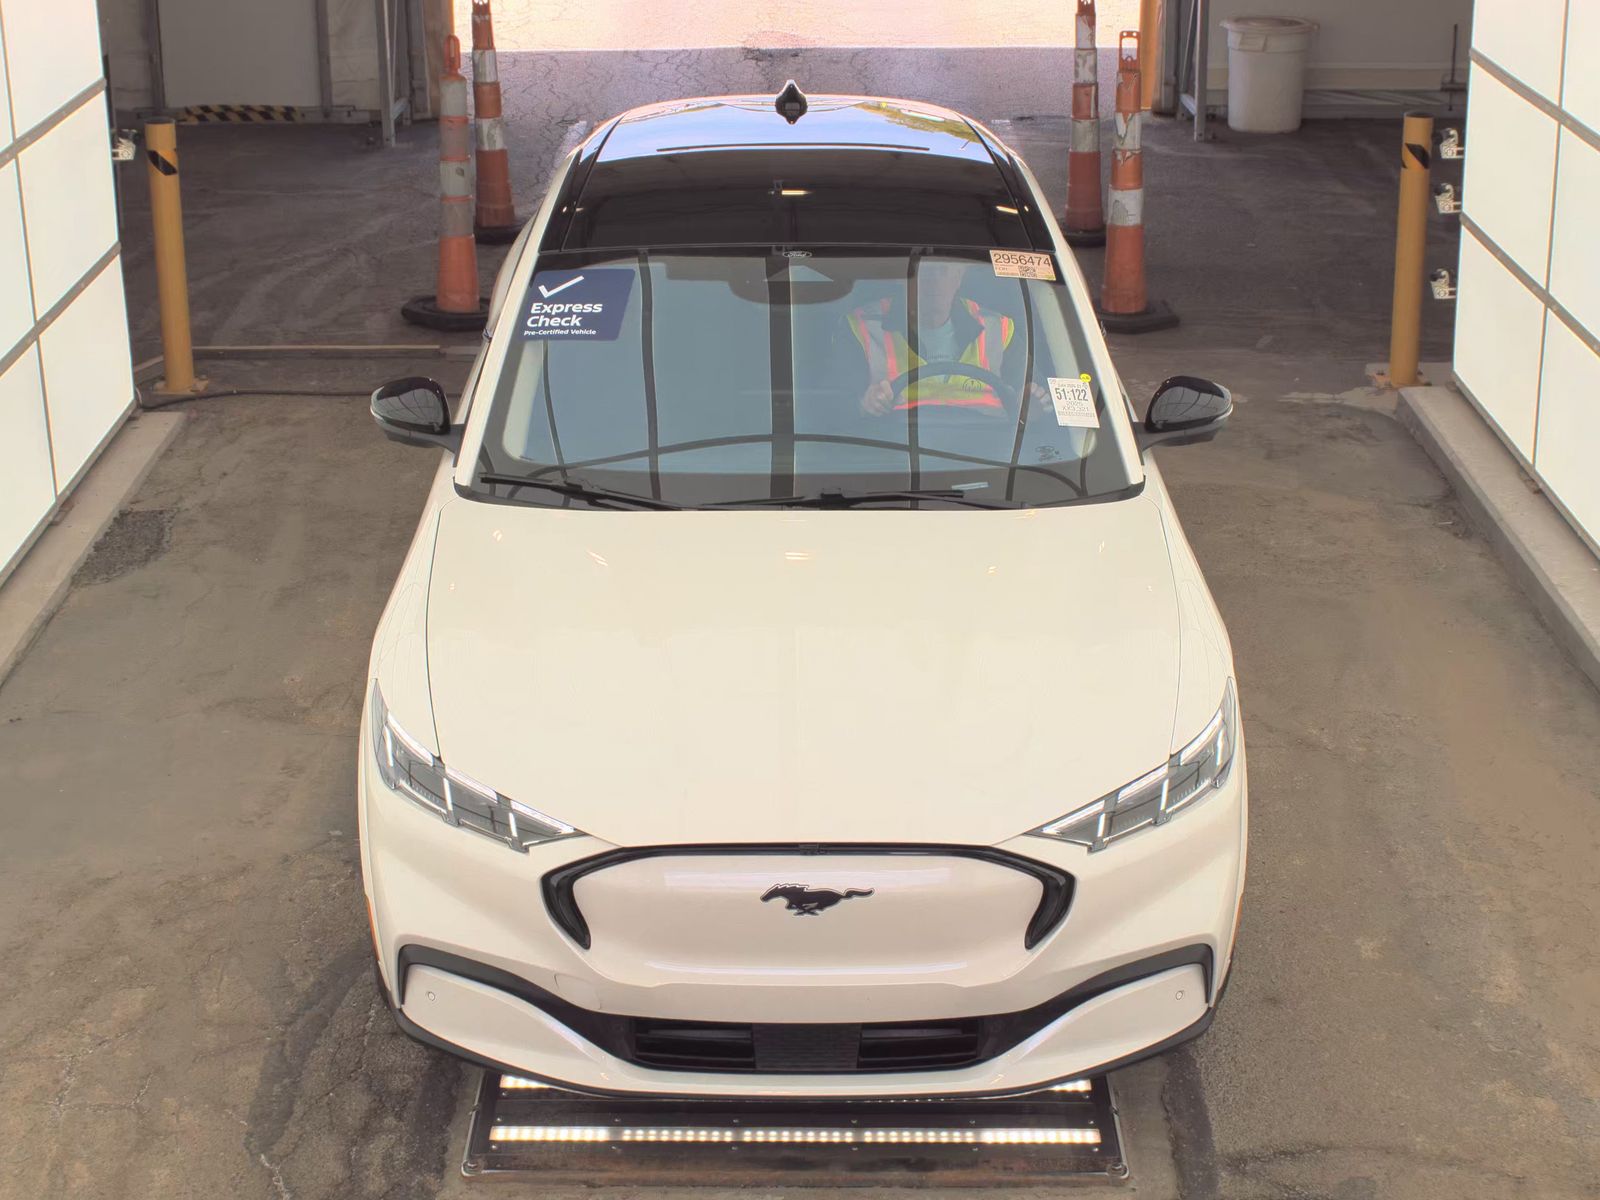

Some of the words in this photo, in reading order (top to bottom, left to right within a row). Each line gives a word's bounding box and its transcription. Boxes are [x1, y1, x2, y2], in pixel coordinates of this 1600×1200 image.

[993, 253, 1051, 267] 2956474
[530, 302, 603, 315] Express
[526, 314, 583, 328] Check
[523, 328, 570, 336] Pre-Certified
[570, 328, 597, 336] Vehicle
[1055, 387, 1089, 402] 51:122
